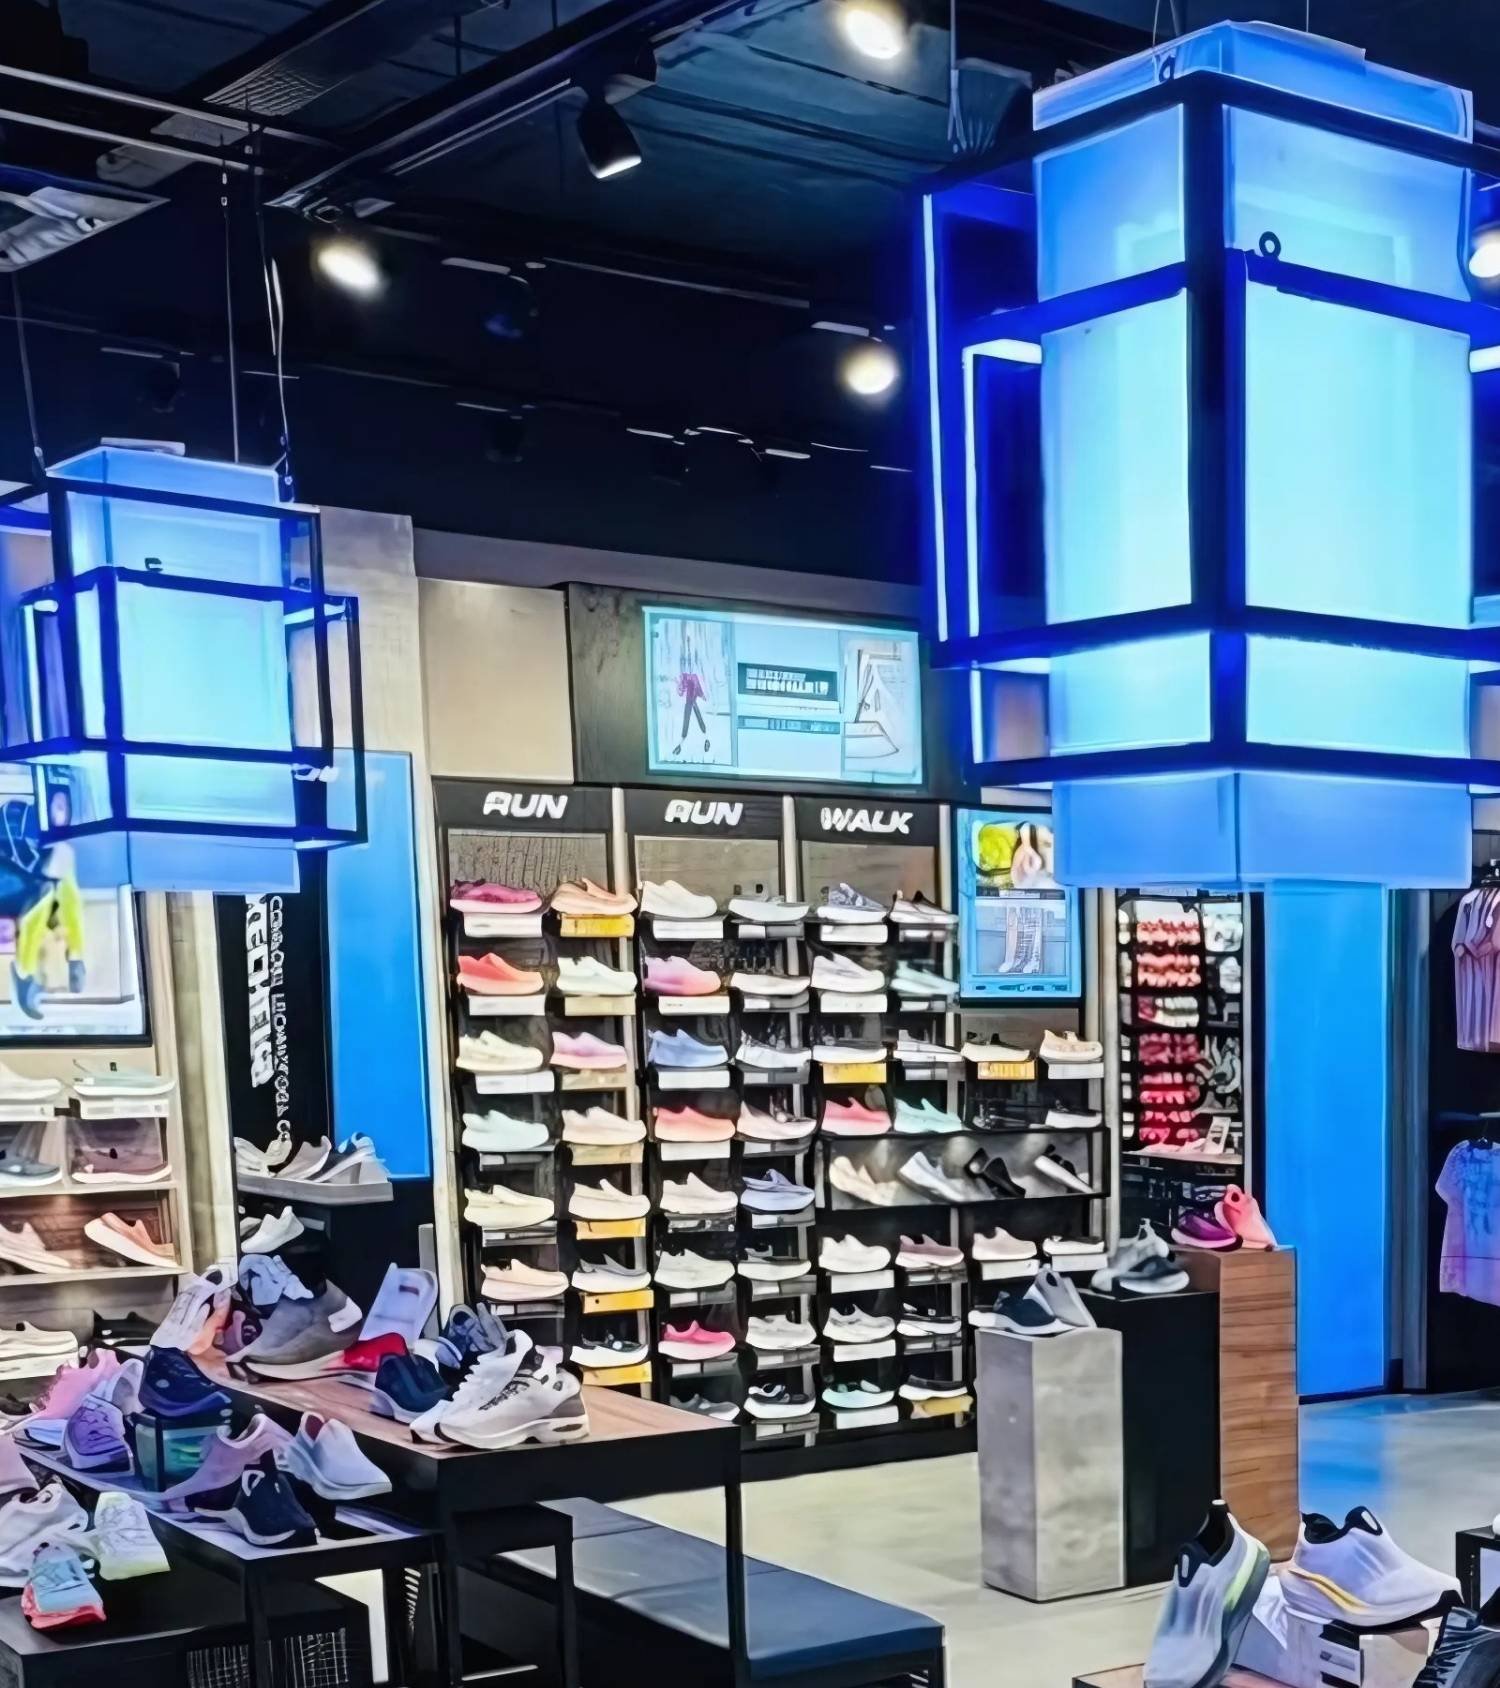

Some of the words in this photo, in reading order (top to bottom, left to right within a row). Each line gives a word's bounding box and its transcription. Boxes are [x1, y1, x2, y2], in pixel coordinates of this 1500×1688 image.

[483, 791, 569, 820] RUN
[664, 799, 744, 826] RUN
[820, 806, 915, 834] WALK
